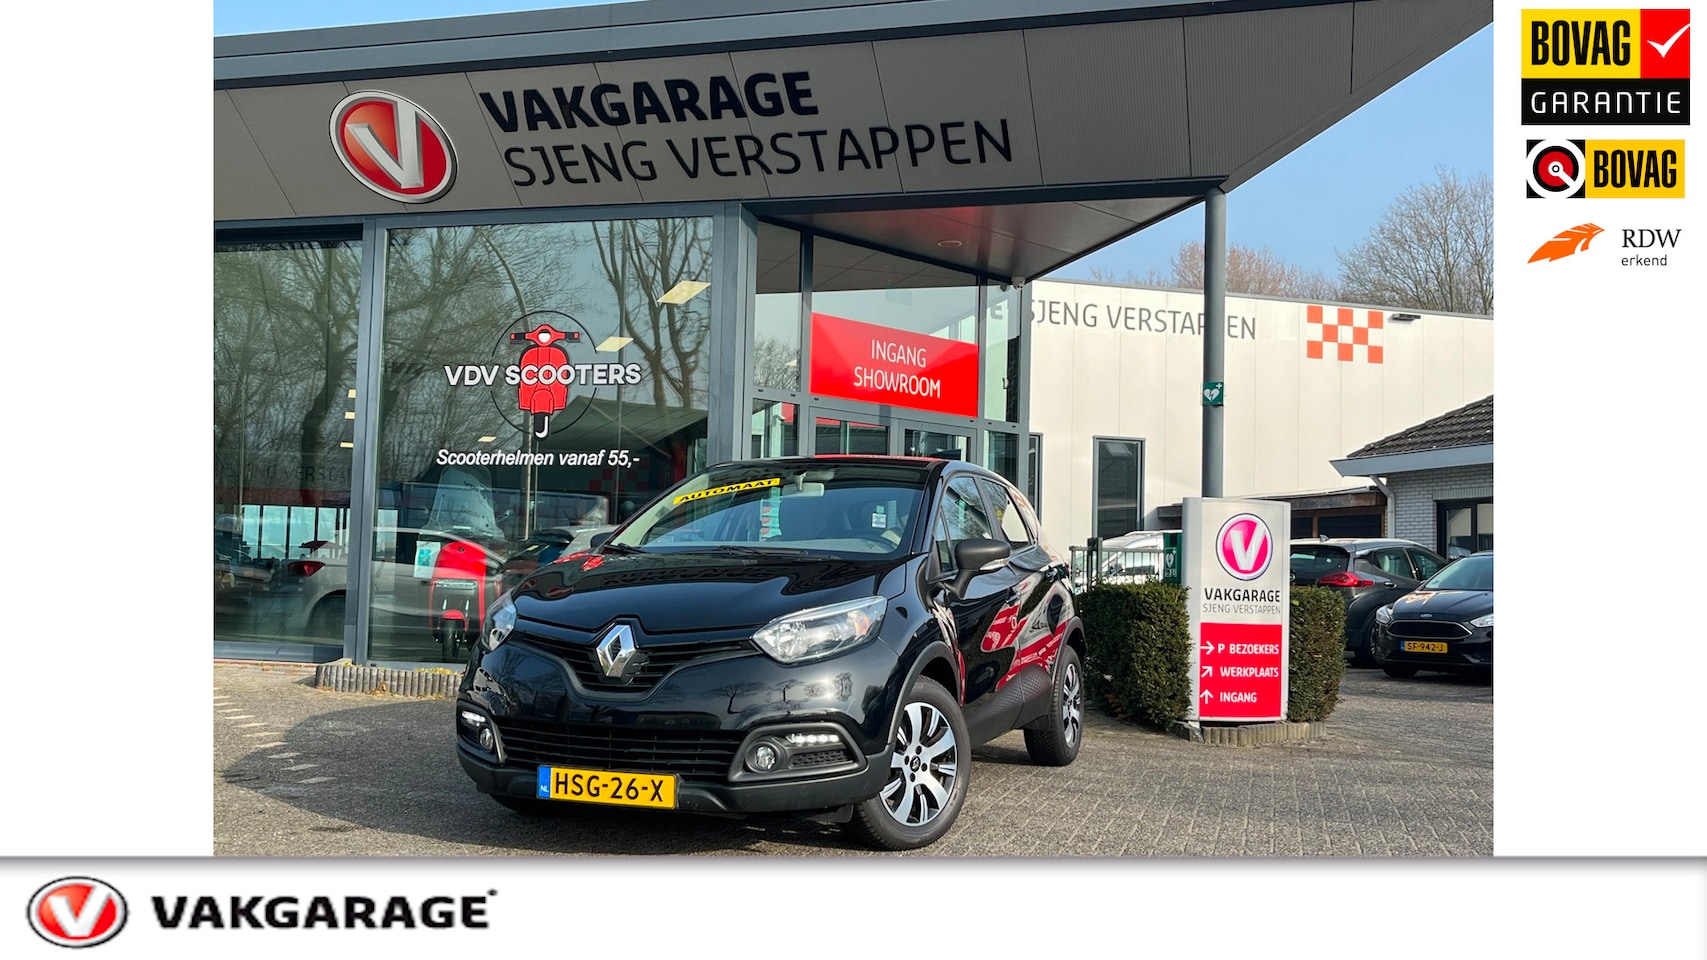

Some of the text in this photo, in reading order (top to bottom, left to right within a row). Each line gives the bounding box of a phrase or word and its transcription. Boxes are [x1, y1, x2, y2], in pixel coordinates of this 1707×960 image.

[479, 71, 819, 133] VAKGARAGE
[504, 118, 1013, 187] SJENG VERSTAPPEN
[870, 339, 927, 368] INGANG
[444, 362, 642, 387] VDV SCOOTERS
[853, 366, 941, 399] SHOWROOM
[436, 448, 641, 468] Scooterhelmen vanaf 55,-
[679, 480, 776, 501] AUTOMAAT
[1204, 587, 1280, 602] VAKGARAGE
[1203, 603, 1280, 615] SJENG VERSTAPPEN
[1218, 643, 1279, 655] P BEZOEKERS
[1220, 666, 1279, 678] WERKPLAATS
[1220, 691, 1257, 703] INGANG
[540, 785, 549, 793] NL
[555, 772, 664, 802] HSG-26-X
